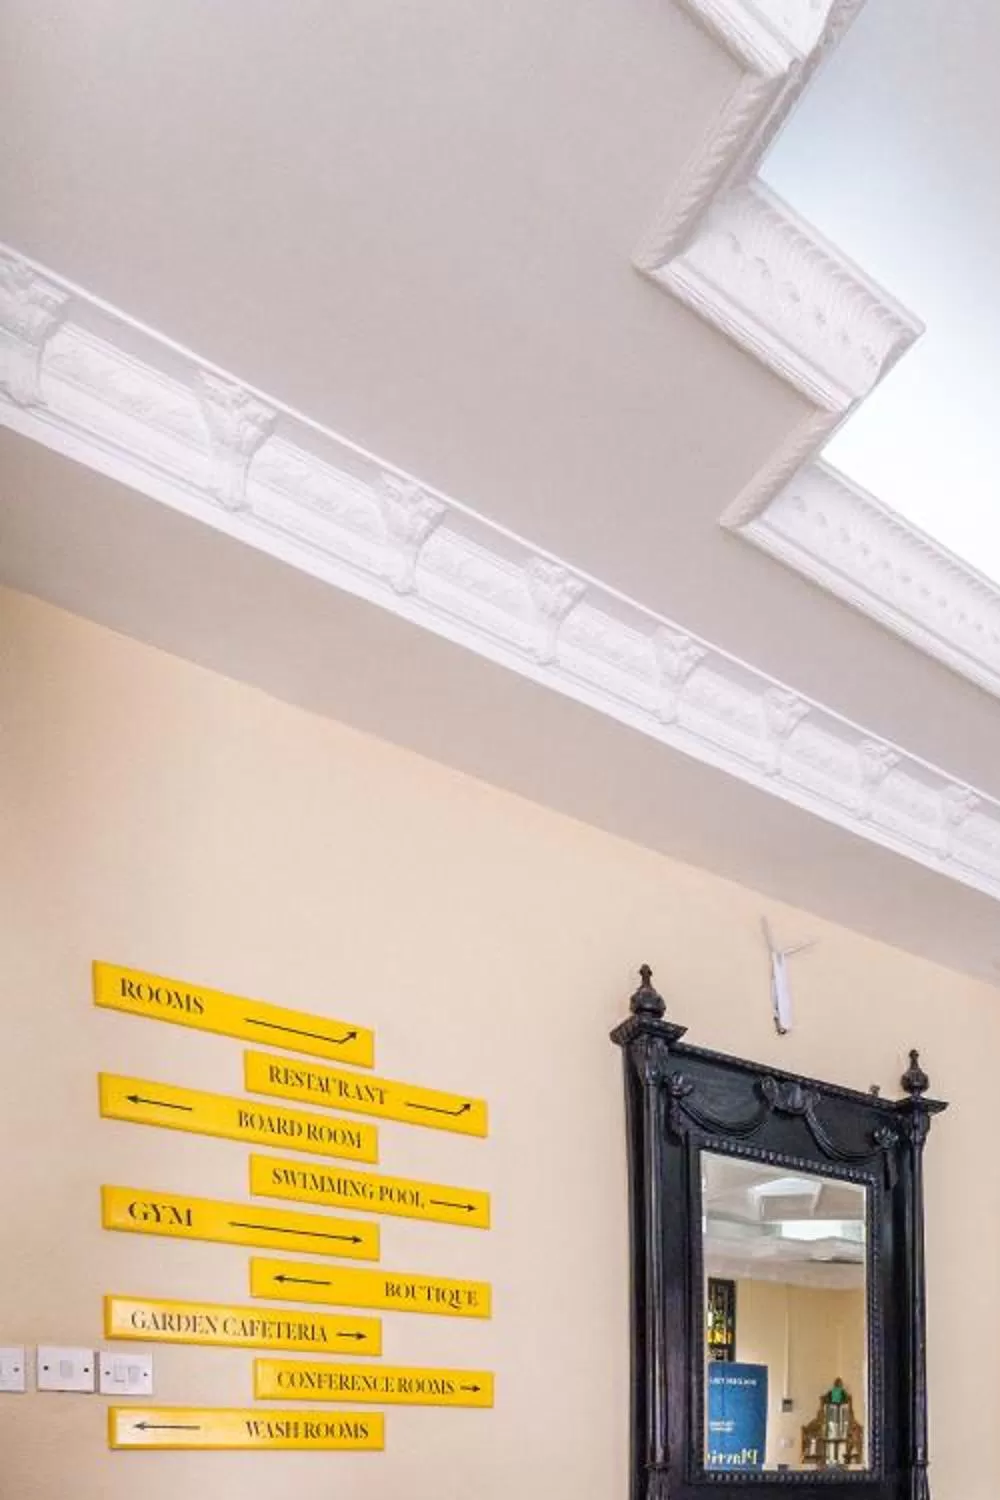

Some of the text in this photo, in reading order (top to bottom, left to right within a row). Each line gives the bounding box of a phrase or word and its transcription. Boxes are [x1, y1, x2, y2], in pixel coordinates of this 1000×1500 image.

[119, 977, 205, 1015] ROOMS
[269, 1063, 388, 1105] RESTAURANT
[238, 1109, 362, 1149] BOARD ROOM
[272, 1167, 425, 1209] SWIMMING POOL
[128, 1200, 193, 1227] GYM
[384, 1280, 479, 1309] BOUTIQUE
[131, 1309, 329, 1344] GARDEN CAFETERIA
[276, 1370, 455, 1395] CONFERENCE ROOMS
